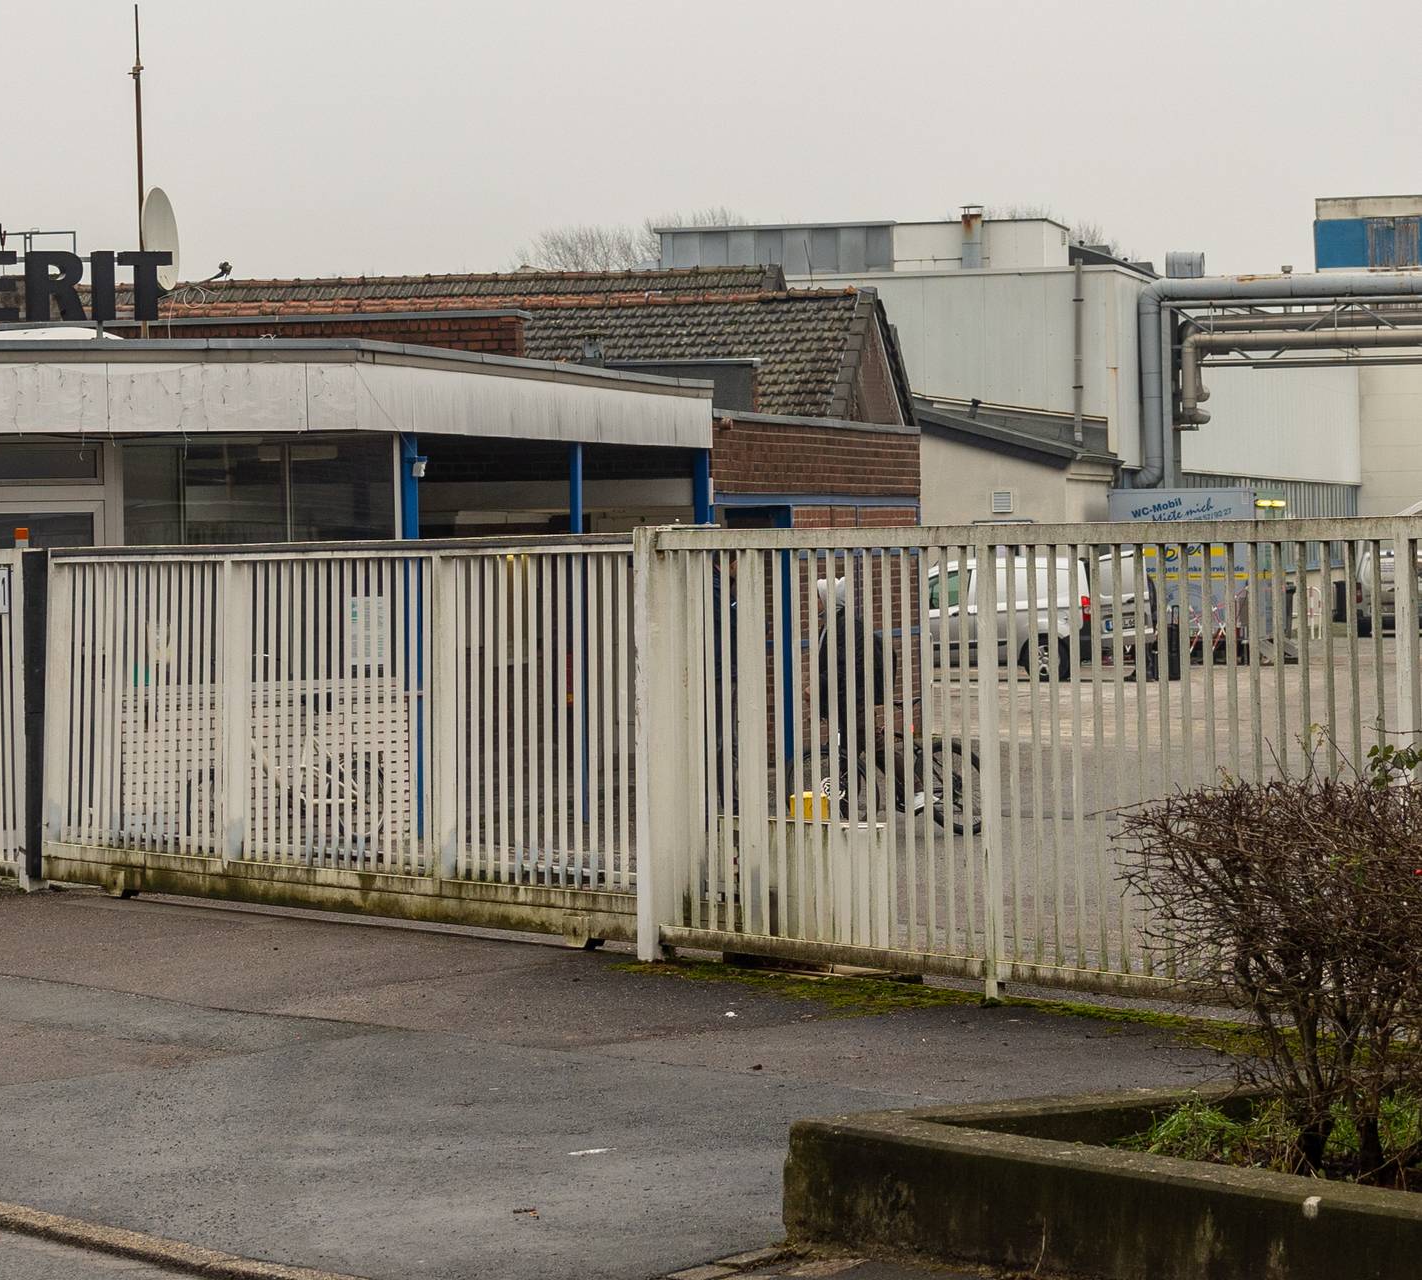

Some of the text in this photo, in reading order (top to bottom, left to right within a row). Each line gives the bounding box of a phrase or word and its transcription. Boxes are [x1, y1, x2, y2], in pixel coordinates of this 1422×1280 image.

[1131, 498, 1182, 519] WC-Mobil
[1185, 497, 1214, 516] mich
[1, 577, 6, 606] 1
